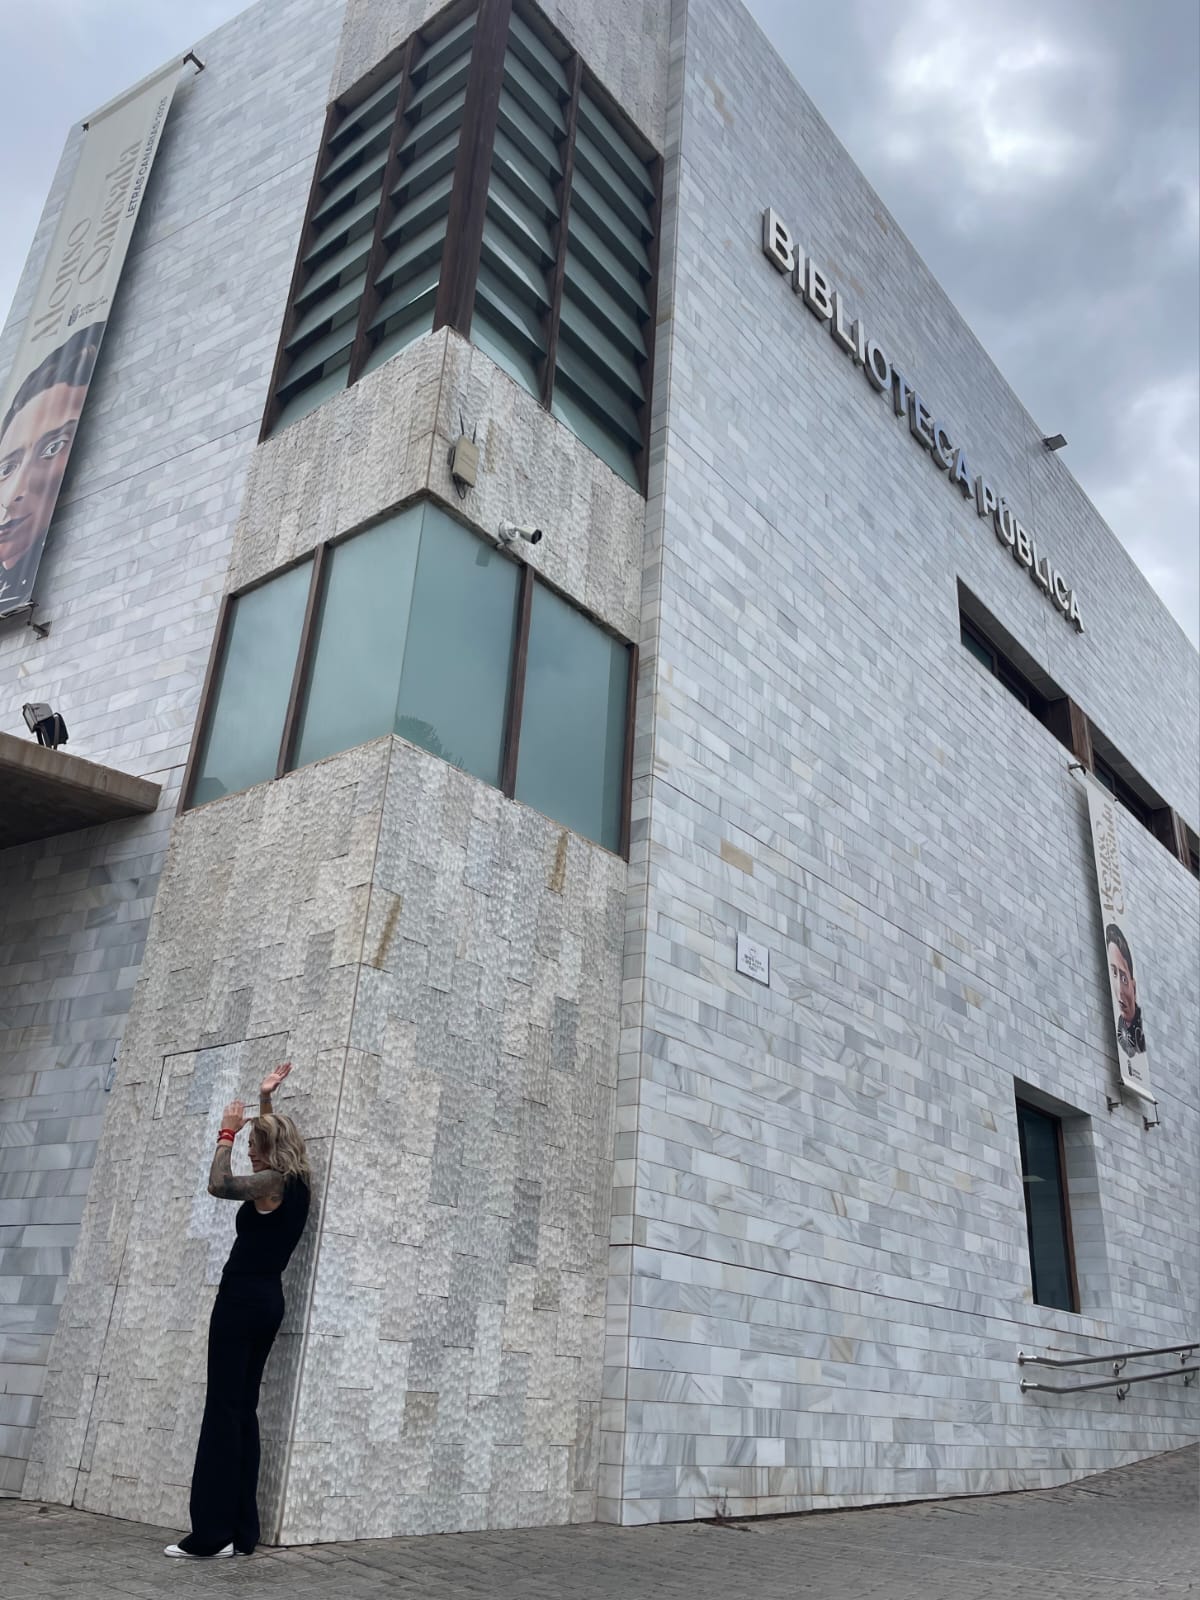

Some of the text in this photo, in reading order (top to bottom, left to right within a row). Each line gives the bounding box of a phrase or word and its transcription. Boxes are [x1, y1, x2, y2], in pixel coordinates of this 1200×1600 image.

[78, 140, 143, 286] Quesada
[126, 175, 145, 218] LETRAS
[139, 122, 159, 175] CANARIAS
[31, 217, 91, 342] Alonso
[763, 207, 1085, 634] BIBLIOTECA PÚBLICA
